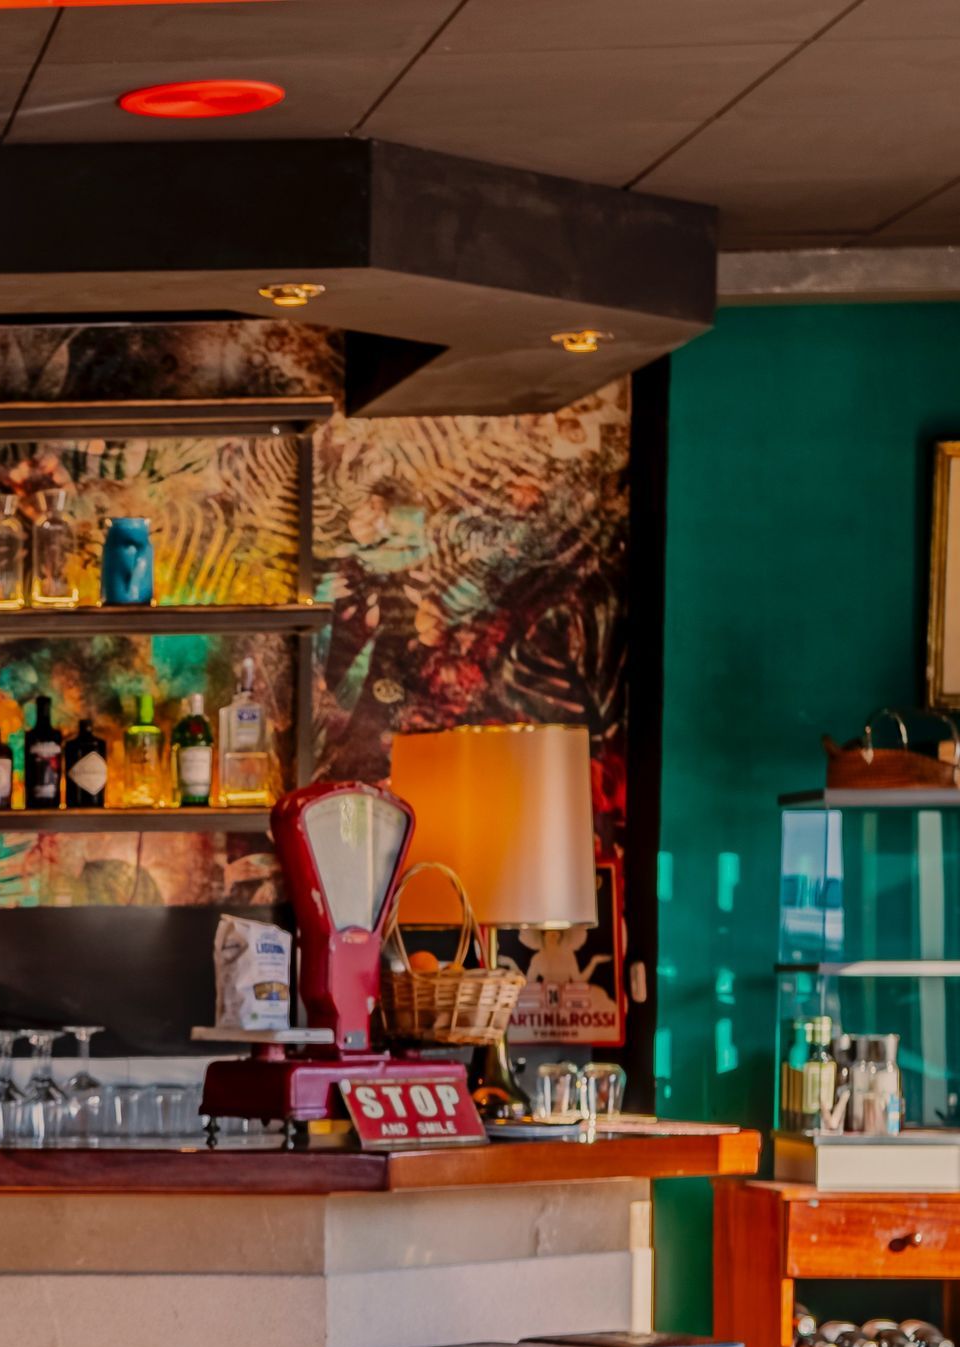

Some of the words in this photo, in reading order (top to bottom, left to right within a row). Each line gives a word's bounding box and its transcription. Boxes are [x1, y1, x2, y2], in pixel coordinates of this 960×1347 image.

[508, 1012, 560, 1027] ARTINI
[569, 1012, 615, 1027] ROSSI
[355, 1084, 460, 1119] STOP
[380, 1122, 409, 1136] AND
[416, 1120, 458, 1135] SMILE
